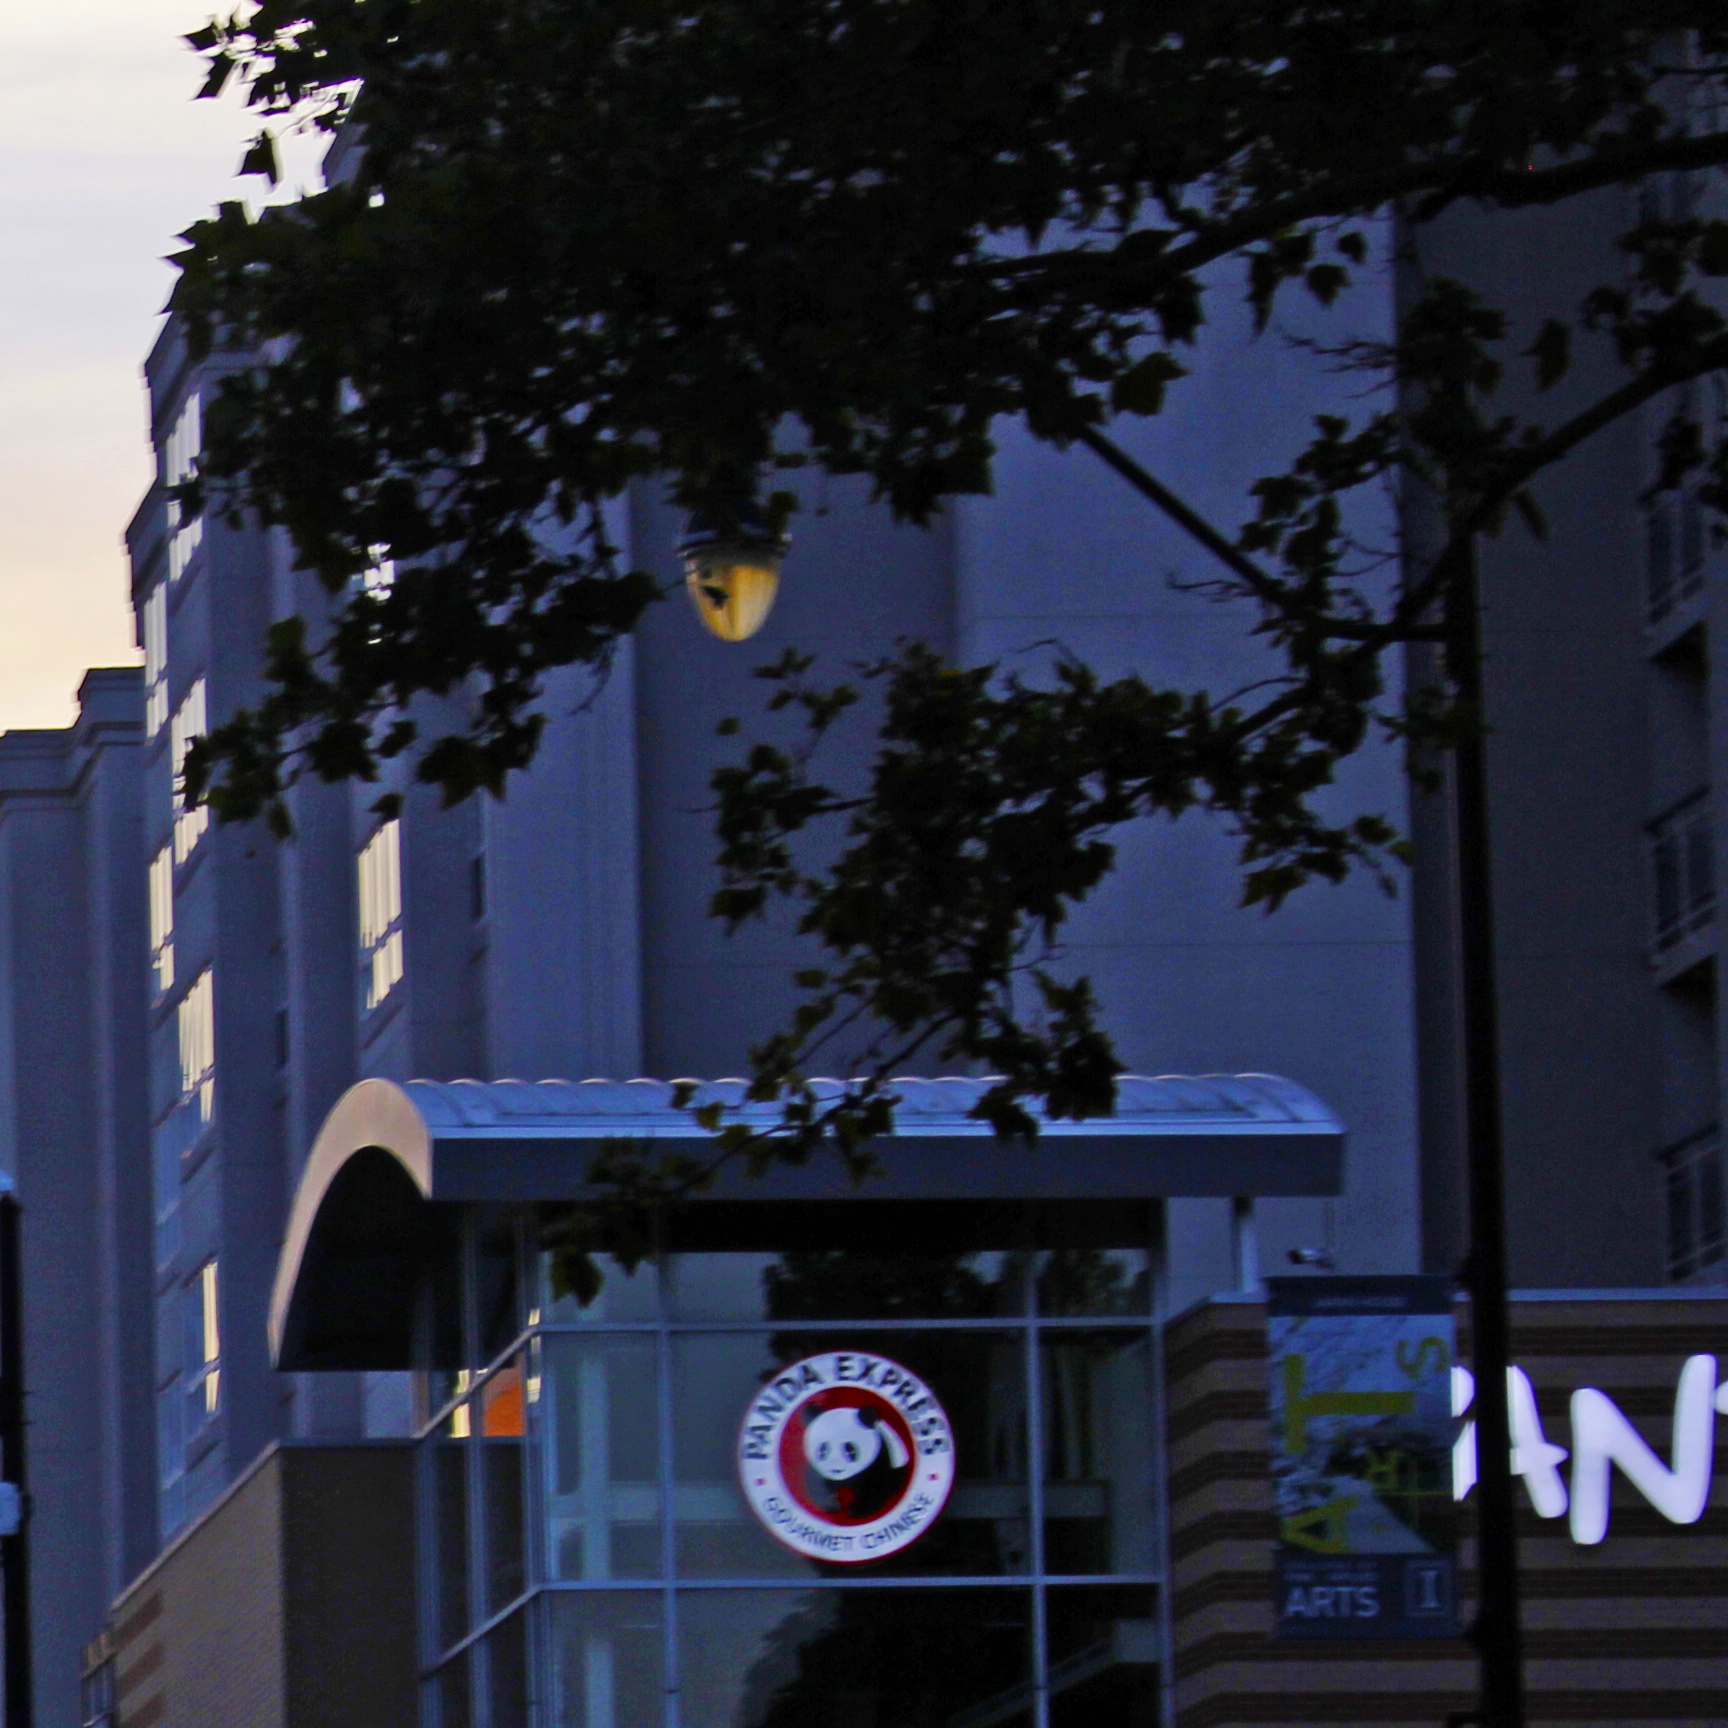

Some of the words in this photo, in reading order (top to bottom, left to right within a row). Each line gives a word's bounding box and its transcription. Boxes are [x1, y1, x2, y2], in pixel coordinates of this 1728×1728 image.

[743, 1363, 823, 1461] PANDA
[835, 1354, 949, 1456] EXPRESS
[764, 1496, 854, 1551] GOURMET
[859, 1492, 933, 1550] CHINESE
[1283, 1585, 1381, 1619] ARTS
